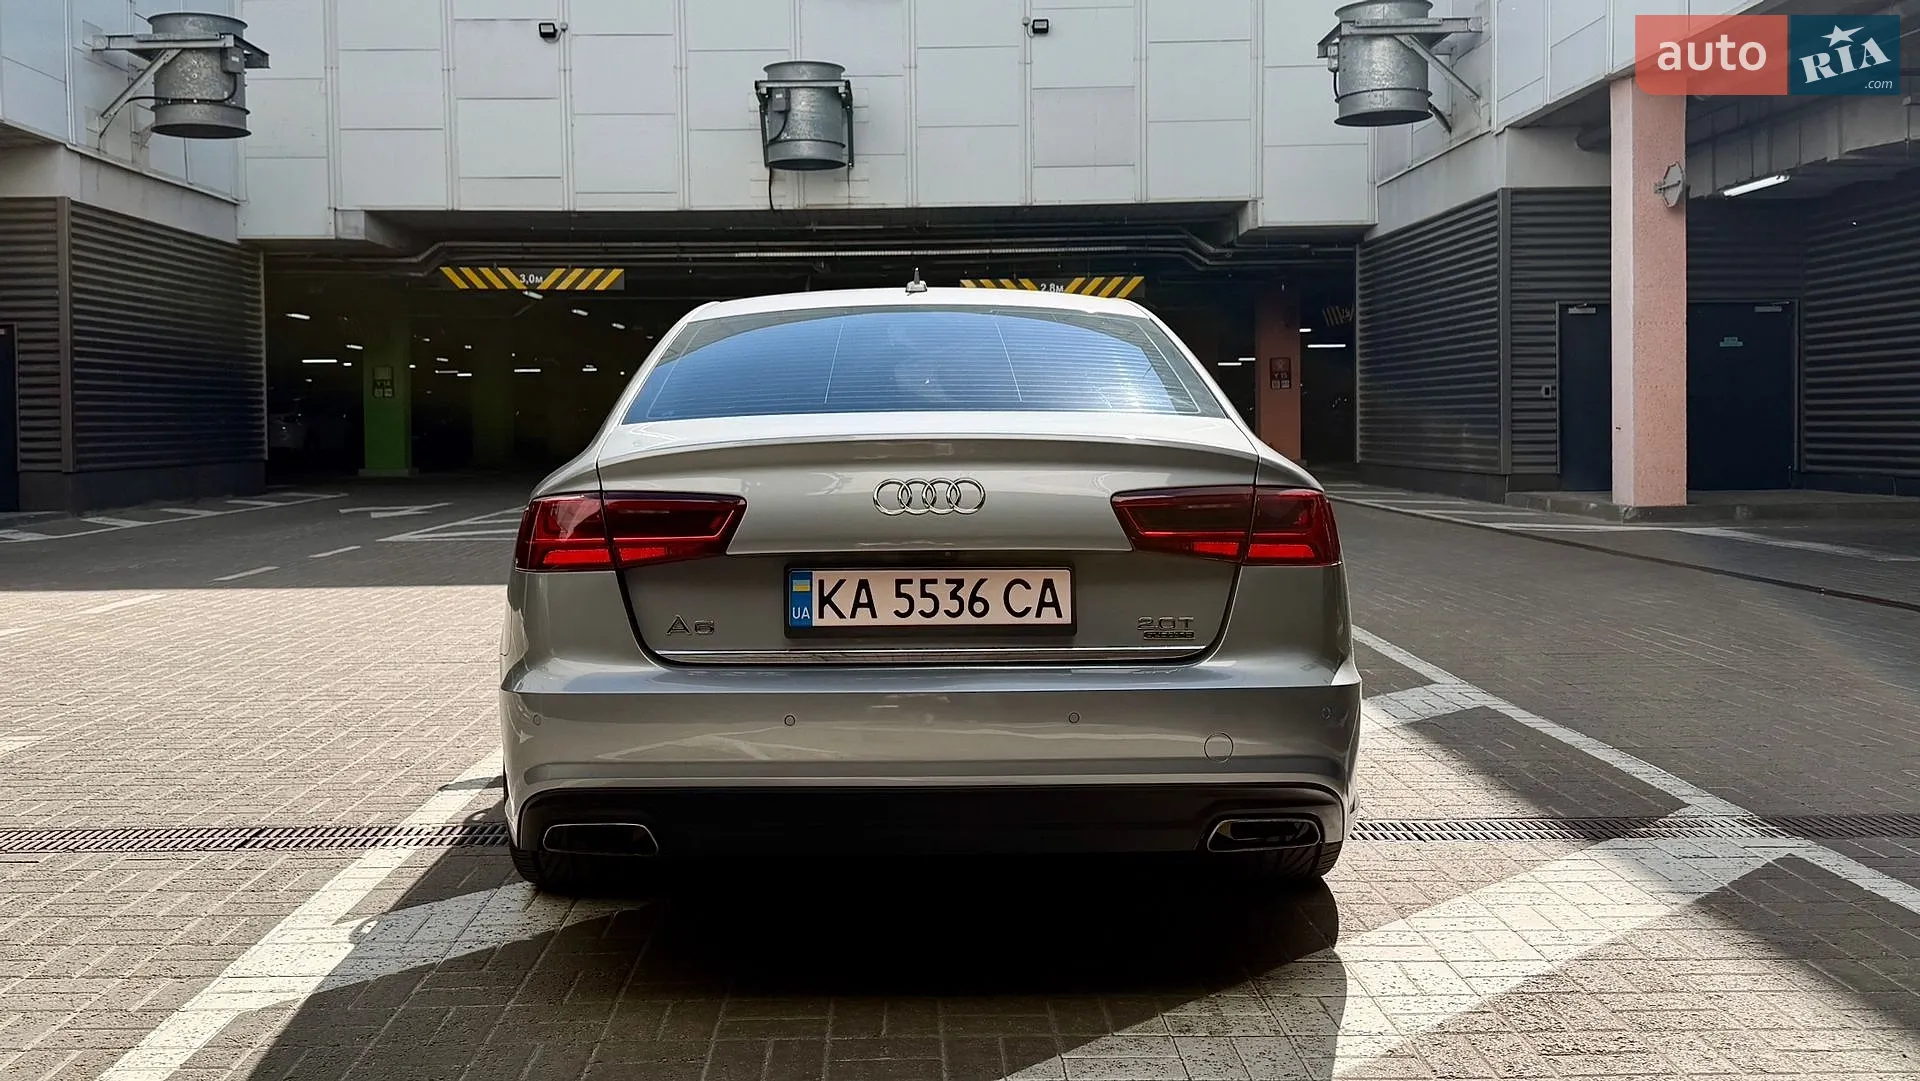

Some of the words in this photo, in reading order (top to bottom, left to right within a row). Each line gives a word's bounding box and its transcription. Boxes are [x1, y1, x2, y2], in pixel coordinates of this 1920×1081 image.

[818, 578, 878, 619] KA
[893, 578, 989, 619] 5536
[1003, 578, 1063, 619] CA
[792, 606, 811, 619] UA
[665, 614, 714, 635] A6
